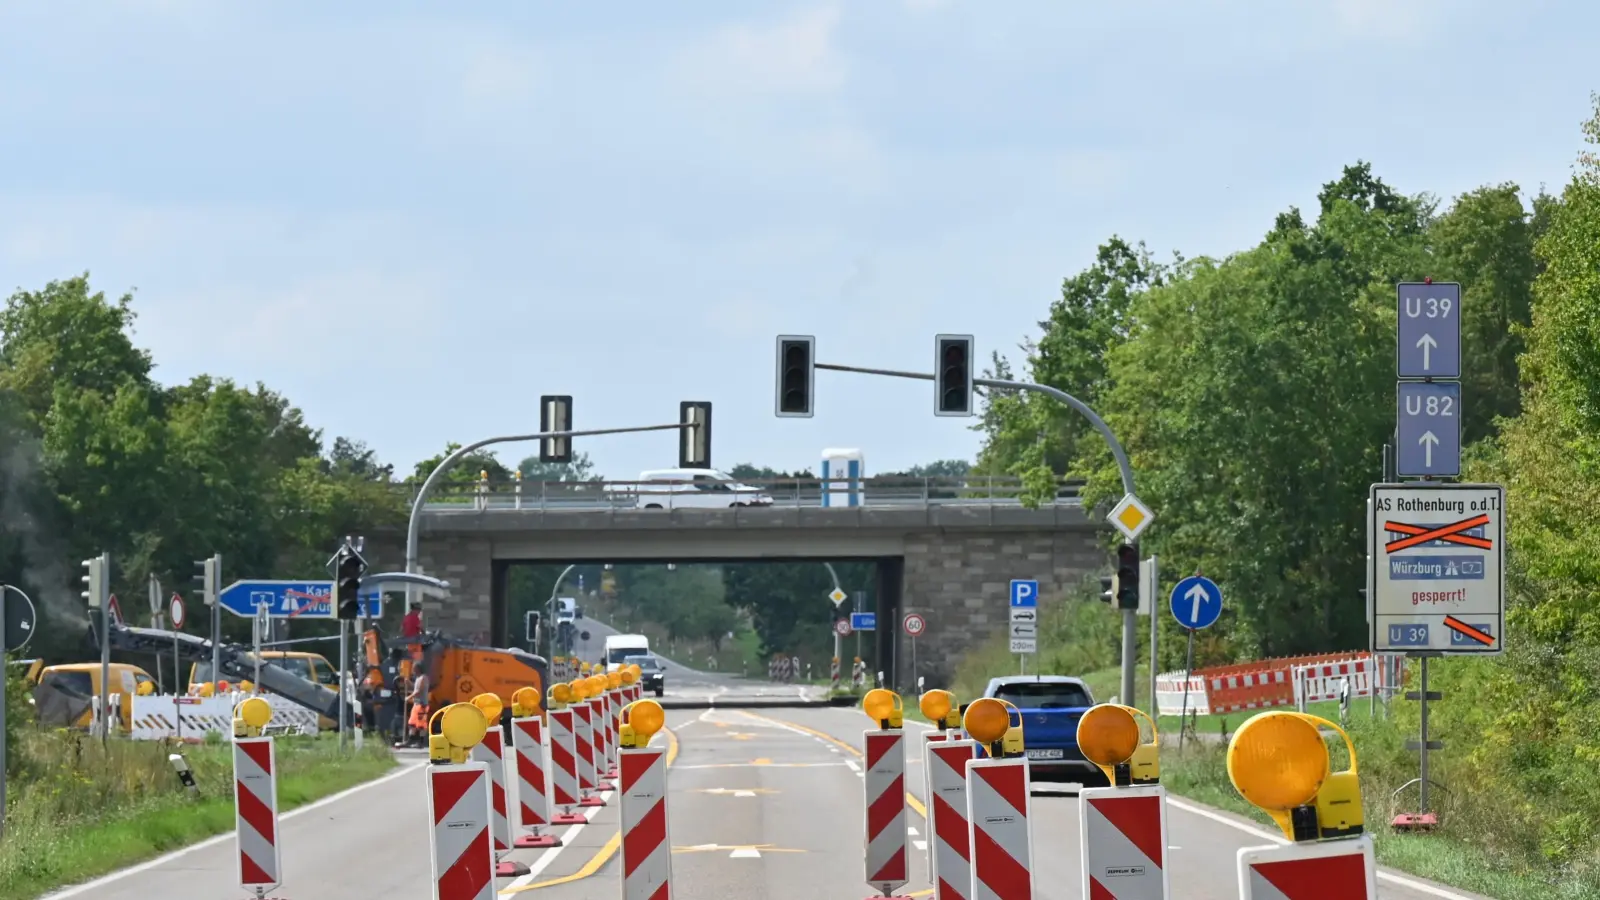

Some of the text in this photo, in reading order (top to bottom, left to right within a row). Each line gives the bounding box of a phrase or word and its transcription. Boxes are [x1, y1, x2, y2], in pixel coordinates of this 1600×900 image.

[1406, 297, 1452, 318] U 39
[1406, 395, 1453, 416] U 82
[1376, 497, 1500, 514] AS Rothenburg o.d.T.
[1392, 561, 1441, 577] Würzburg
[1016, 583, 1032, 605] P
[1412, 588, 1466, 605] gesperrt!
[908, 620, 920, 630] 60
[1390, 628, 1401, 642] U
[1409, 628, 1426, 642] 39
